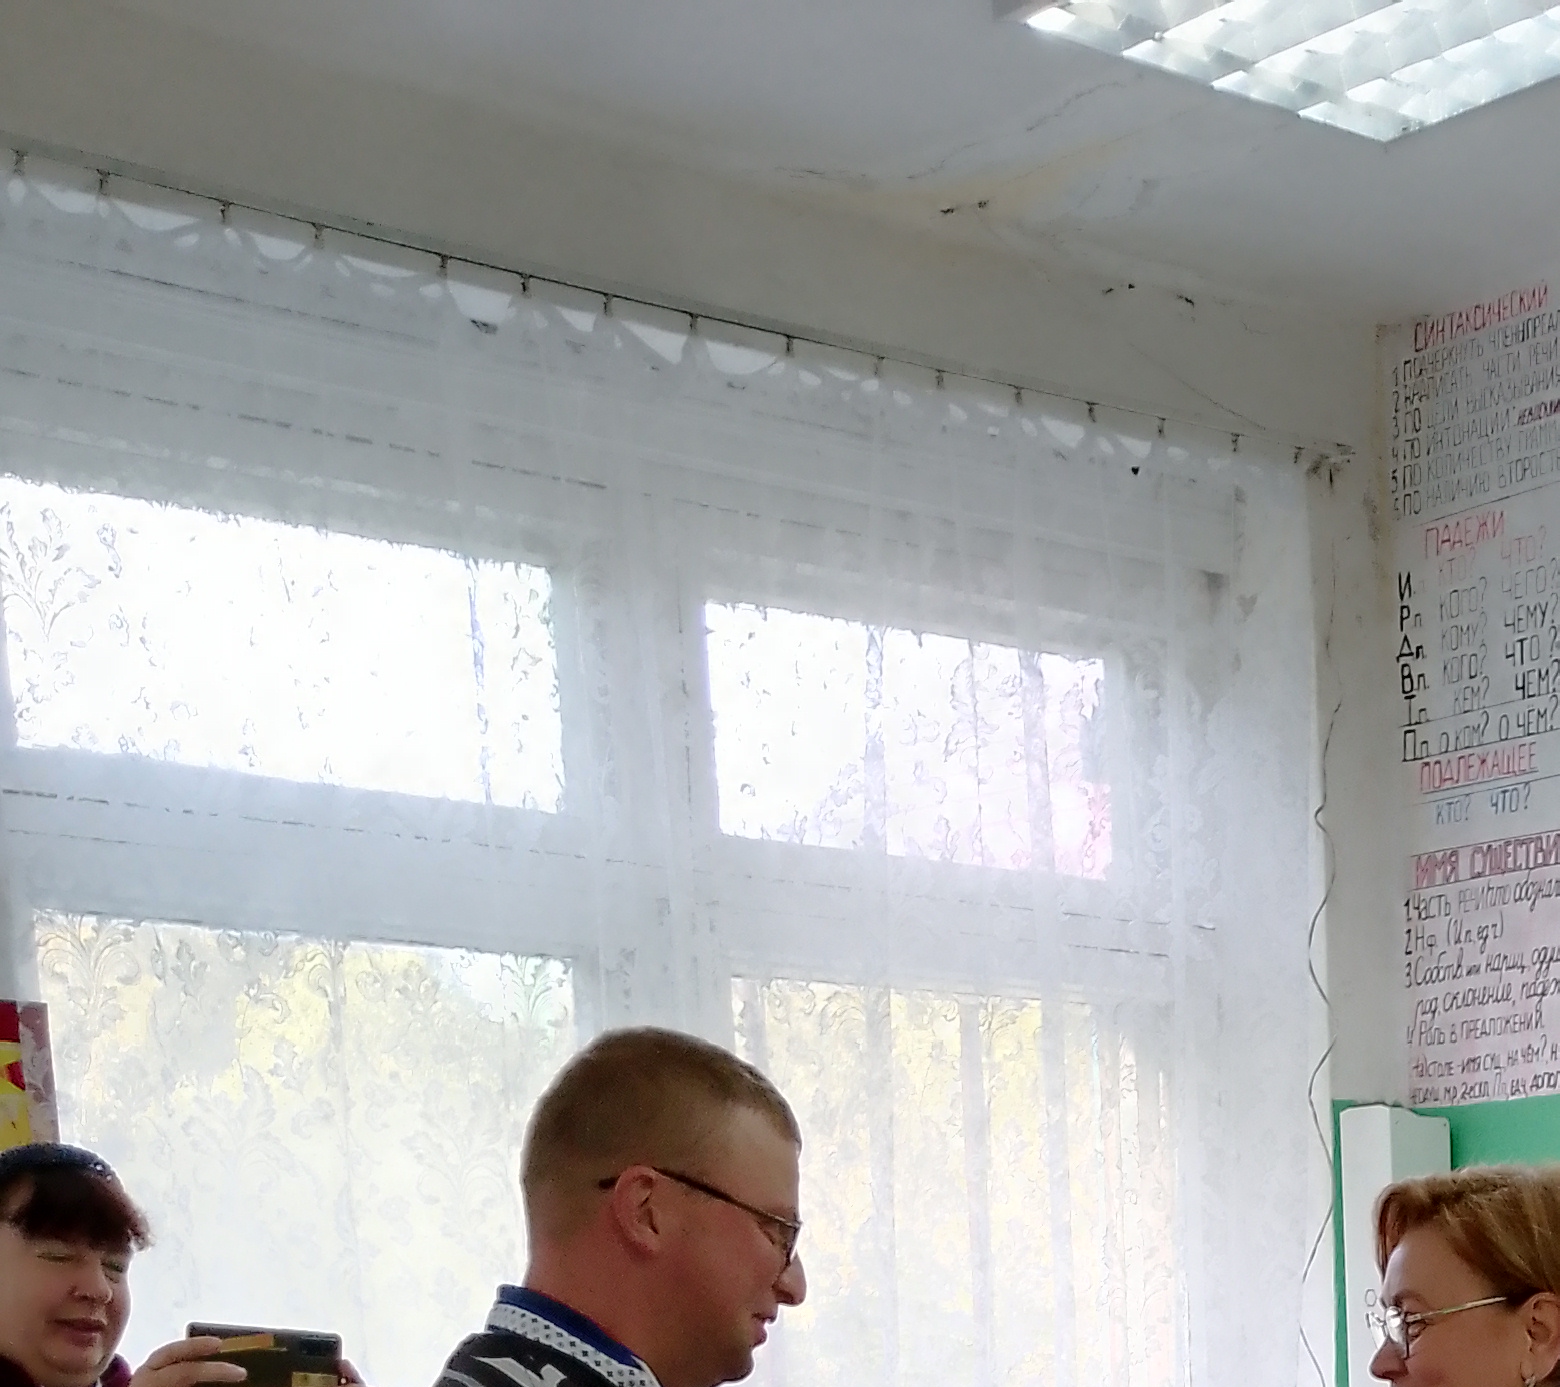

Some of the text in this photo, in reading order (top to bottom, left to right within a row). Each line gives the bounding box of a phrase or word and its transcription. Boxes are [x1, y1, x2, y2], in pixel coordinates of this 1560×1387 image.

[1414, 278, 1549, 353] СИНТАКСИЧЕСКИЙ
[1425, 511, 1505, 560] ПАДЕЖИ
[1420, 741, 1538, 792] ПОДЛЕЖАЩЕЕ
[1490, 781, 1531, 816] ЧТО?
[1413, 853, 1460, 888] ИМЯ
